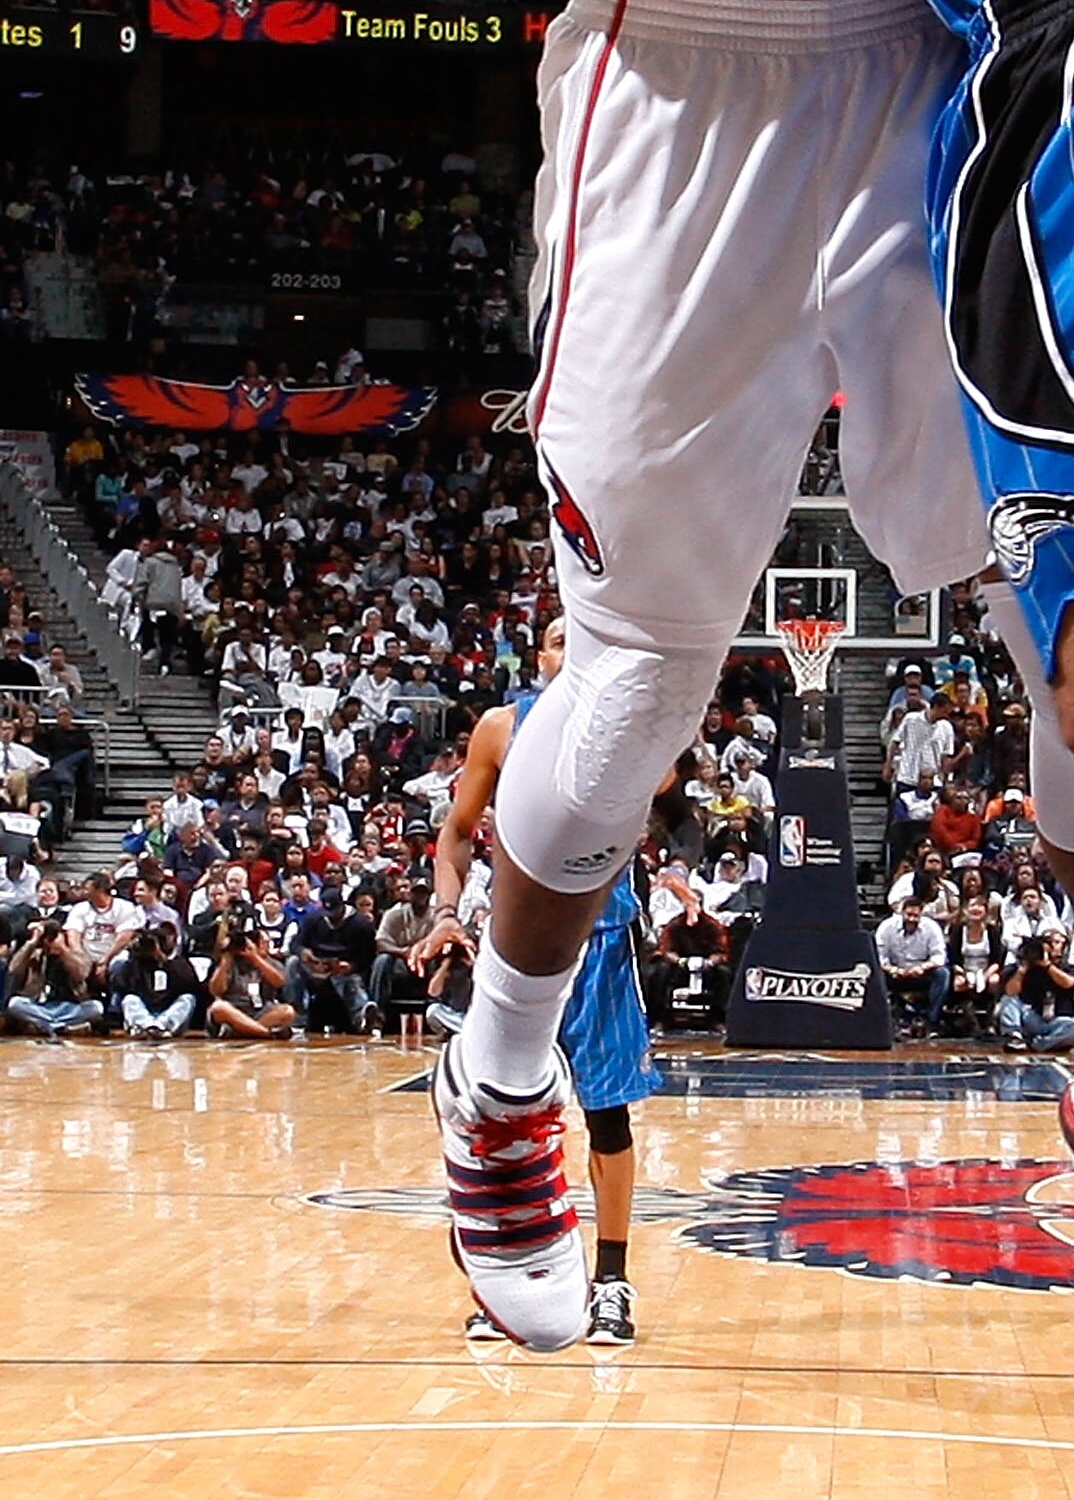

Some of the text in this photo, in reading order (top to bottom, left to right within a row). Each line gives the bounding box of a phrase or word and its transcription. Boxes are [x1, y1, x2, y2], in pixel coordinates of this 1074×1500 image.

[70, 22, 82, 49] 1
[120, 26, 136, 53] 9
[341, 10, 406, 40] Team
[414, 13, 479, 42] Fouls
[486, 16, 502, 42] 3
[271, 272, 341, 289] 202-203
[761, 977, 866, 997] PLAYOFFS
